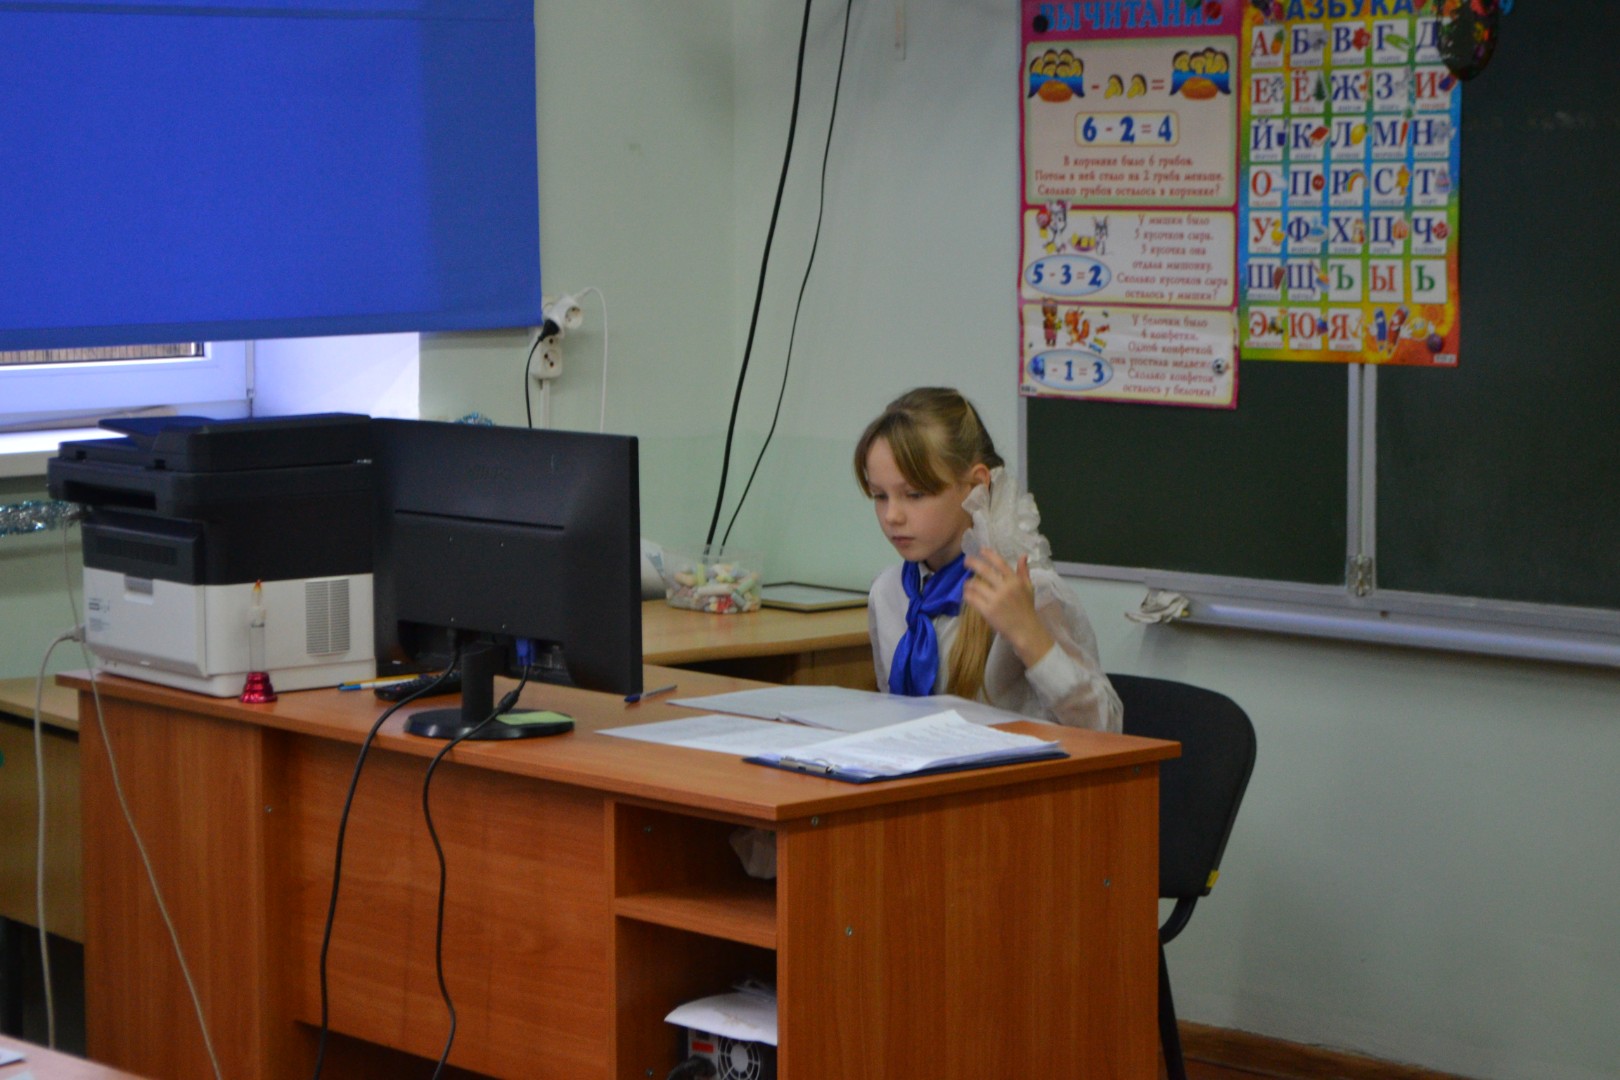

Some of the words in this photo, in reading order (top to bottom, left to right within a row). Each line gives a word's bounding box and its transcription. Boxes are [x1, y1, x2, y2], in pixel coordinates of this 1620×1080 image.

[1286, 0, 1414, 20] АЗБУКА
[1251, 30, 1270, 57] А
[1292, 29, 1309, 54] Б
[1333, 27, 1352, 52] В
[1374, 24, 1394, 51] Г
[1415, 21, 1438, 49] Д
[1253, 78, 1271, 104] Е
[1293, 68, 1312, 103] Ё
[1331, 75, 1361, 100] Ж
[1376, 72, 1393, 99] З
[1415, 72, 1437, 98] И
[1083, 116, 1097, 142] 6
[1120, 116, 1135, 143] 2
[1158, 115, 1172, 142] 4
[1252, 119, 1273, 150] Й
[1293, 123, 1312, 148] К
[1330, 121, 1352, 148] Л
[1373, 120, 1400, 147] М
[1412, 119, 1434, 145] Н
[1121, 155, 1144, 166] было
[1035, 170, 1065, 181] Потом
[1099, 172, 1124, 181] стало
[1252, 170, 1272, 197] О
[1290, 170, 1311, 196] П
[1331, 170, 1351, 196] Р
[1374, 168, 1393, 195] С
[1416, 169, 1436, 195] Т
[1038, 184, 1076, 196] Сколько
[1115, 187, 1155, 196] осталось
[1186, 214, 1210, 225] было
[1252, 217, 1271, 243] У
[1287, 216, 1310, 243] Ф
[1331, 217, 1352, 243] Х
[1371, 216, 1395, 247] Ц
[1413, 217, 1433, 244] Ч
[1032, 264, 1044, 284] 5
[1060, 264, 1072, 285] 3
[1088, 265, 1102, 287] 2
[1117, 273, 1155, 284] Сколько
[1246, 264, 1274, 290] Ш
[1286, 264, 1316, 293] Щ
[1330, 265, 1354, 290] Ъ
[1370, 265, 1396, 292] Ы
[1414, 265, 1435, 291] Ь
[1125, 291, 1164, 299] осталось
[1183, 316, 1208, 327] было
[1250, 312, 1267, 338] Э
[1288, 312, 1315, 339] Ю
[1330, 314, 1349, 340] Я
[1064, 360, 1074, 381] 1
[1093, 361, 1104, 383] 3
[1128, 368, 1166, 379] Сколько
